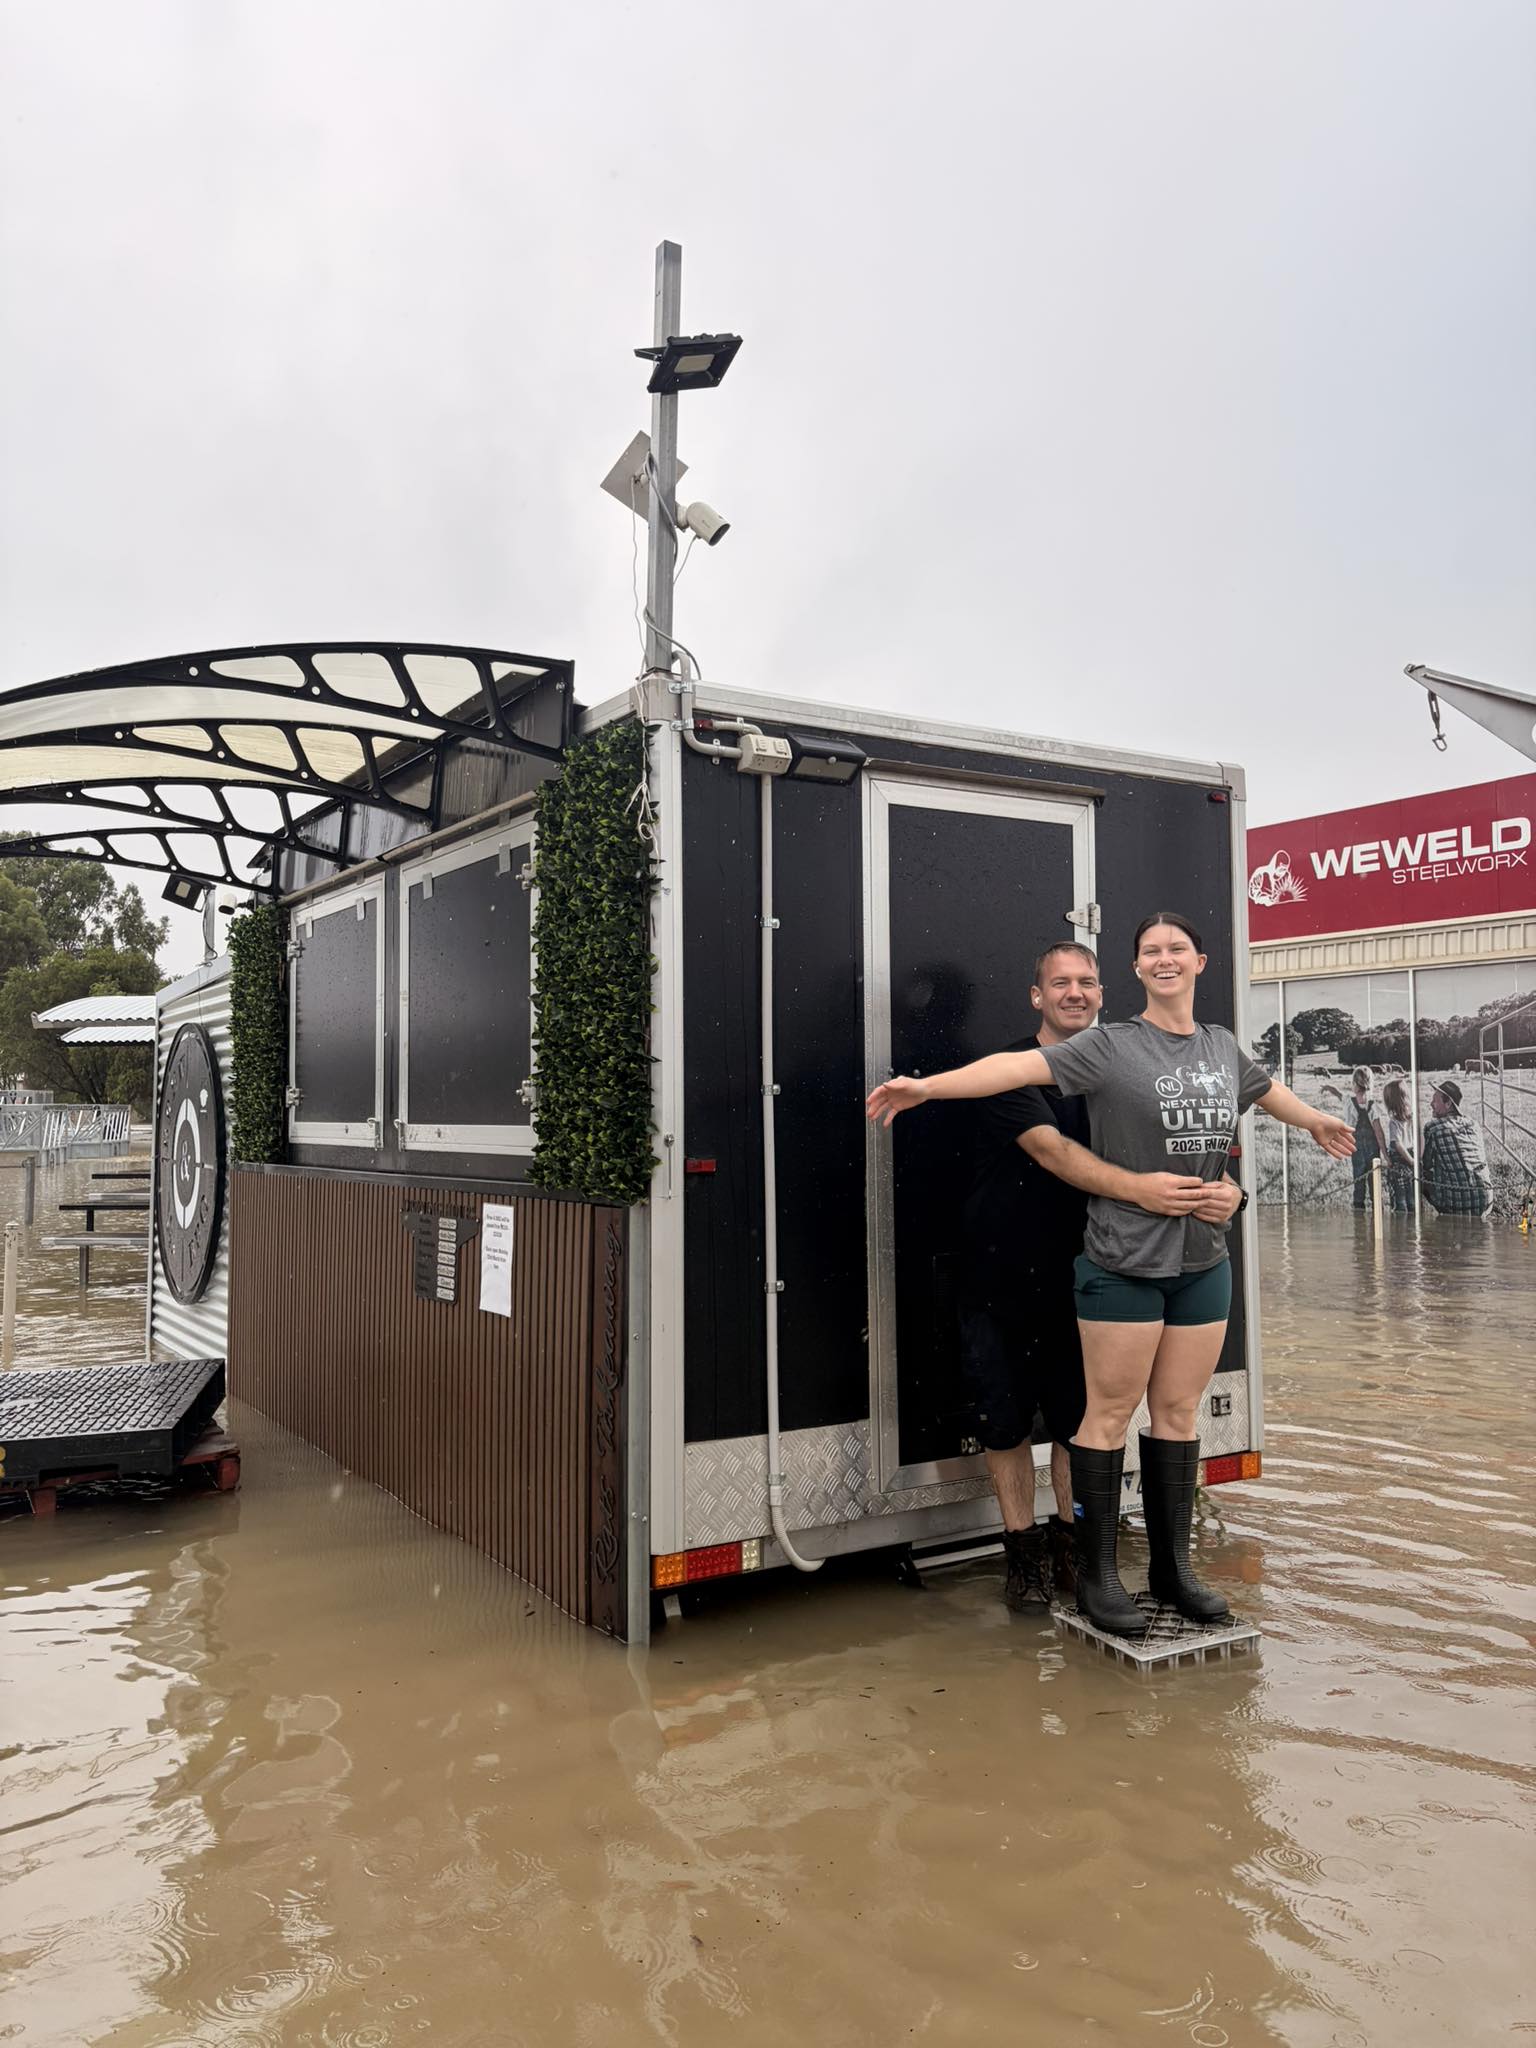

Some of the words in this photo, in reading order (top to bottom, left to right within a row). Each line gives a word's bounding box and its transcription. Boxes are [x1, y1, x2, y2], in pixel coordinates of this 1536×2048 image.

[1310, 817, 1531, 880] WEWELD
[1392, 851, 1528, 885] STEELWORX
[1160, 1099, 1197, 1110] NEXT
[1171, 1140, 1202, 1153] 2025
